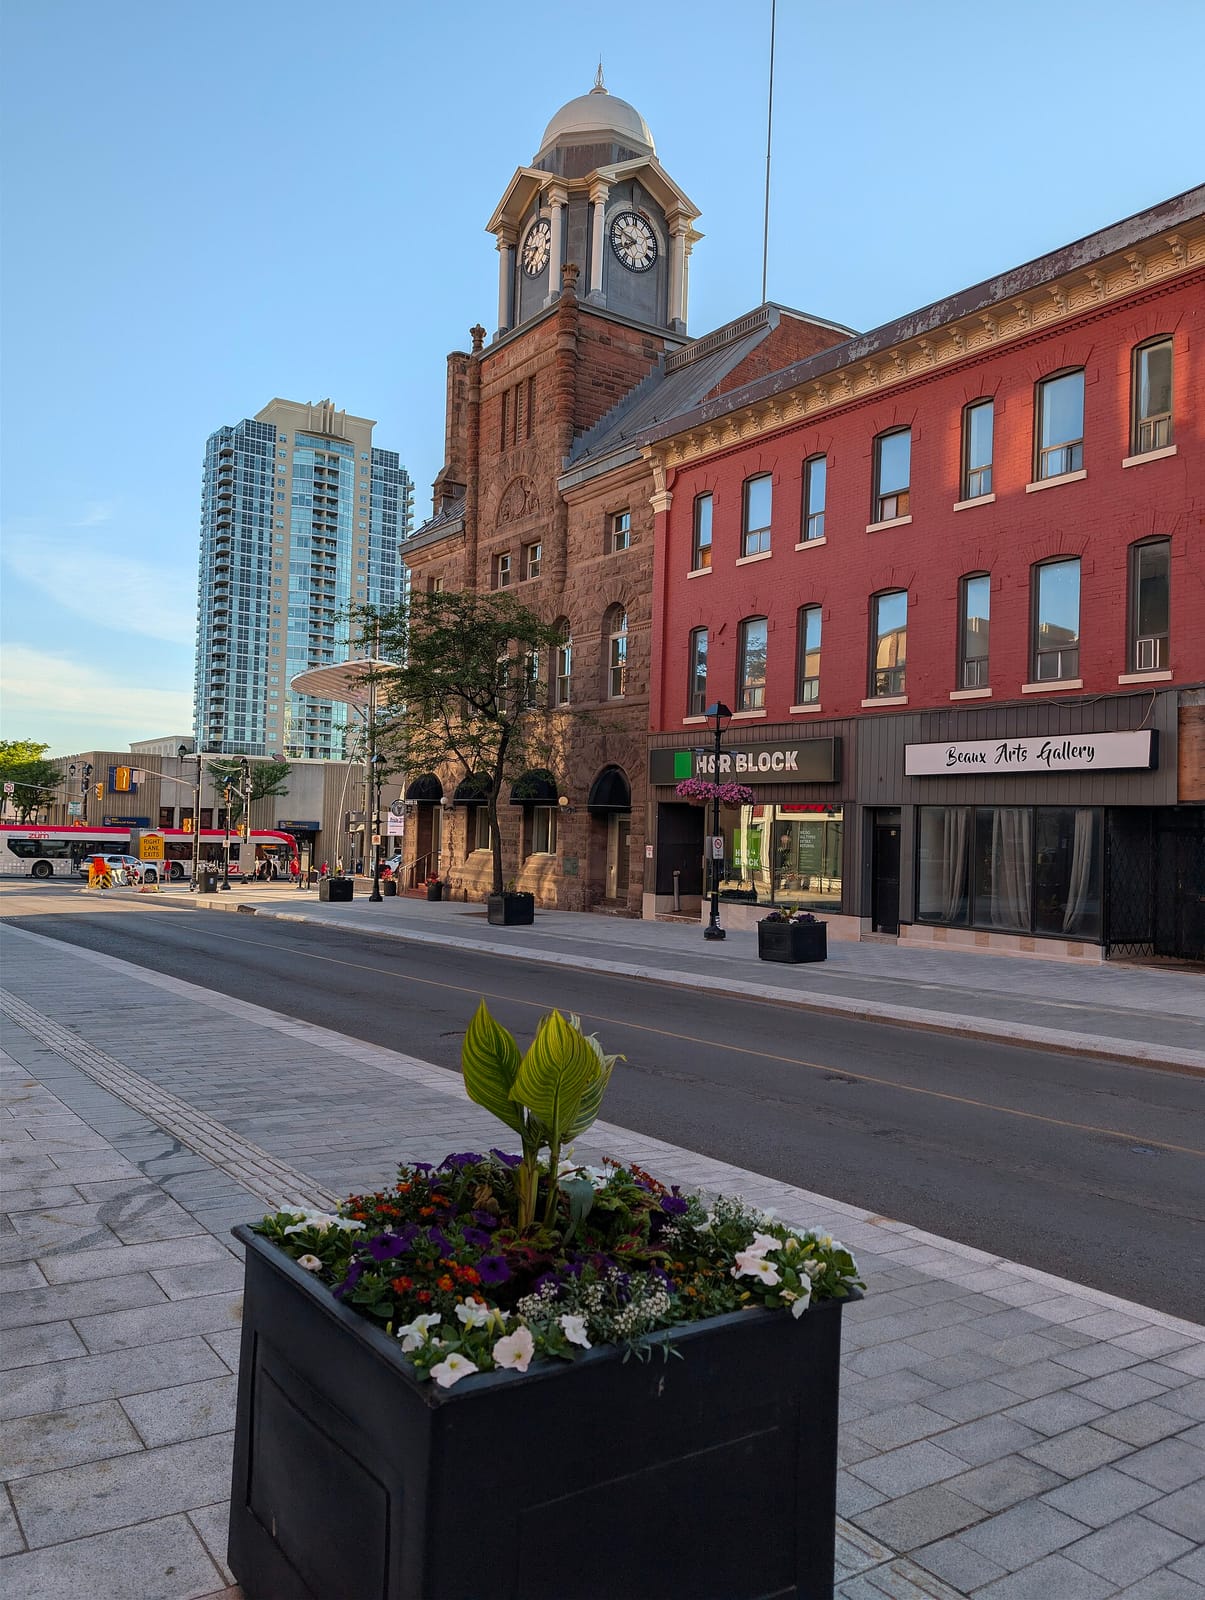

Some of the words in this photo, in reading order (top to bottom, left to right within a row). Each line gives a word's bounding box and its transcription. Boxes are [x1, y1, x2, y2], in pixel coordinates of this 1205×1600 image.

[696, 755, 731, 773] H&R
[736, 751, 799, 773] BLOCK
[946, 746, 987, 767] Beaux
[994, 743, 1028, 764] Arts
[1036, 741, 1095, 767] Gallery
